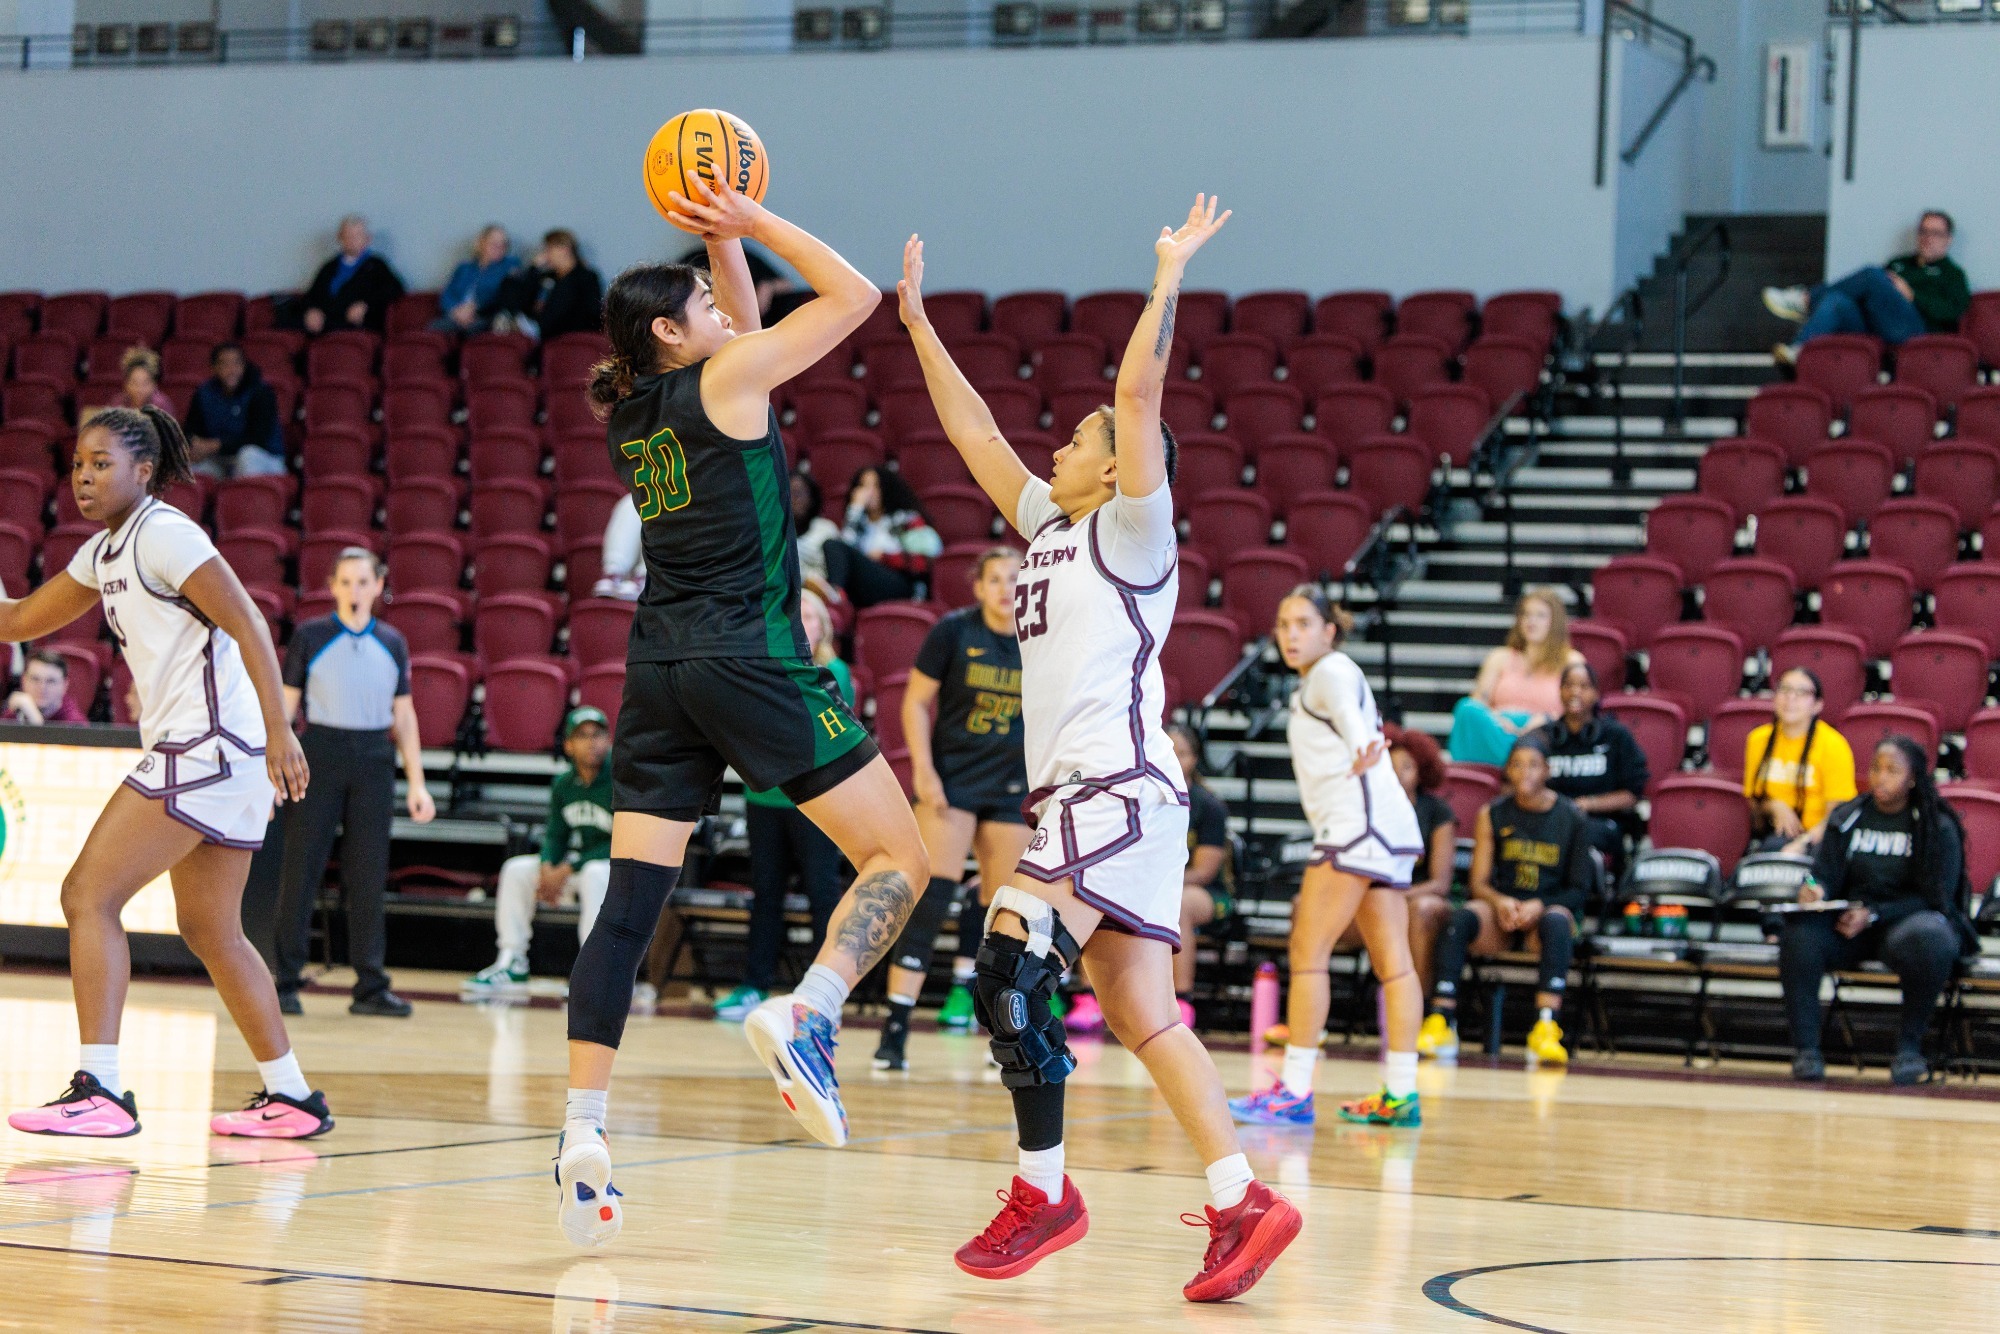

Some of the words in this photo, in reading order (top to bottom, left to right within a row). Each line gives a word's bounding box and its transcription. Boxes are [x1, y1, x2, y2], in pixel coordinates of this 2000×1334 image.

[620, 427, 691, 521] 30
[1015, 578, 1050, 643] 23
[817, 706, 847, 741] H
